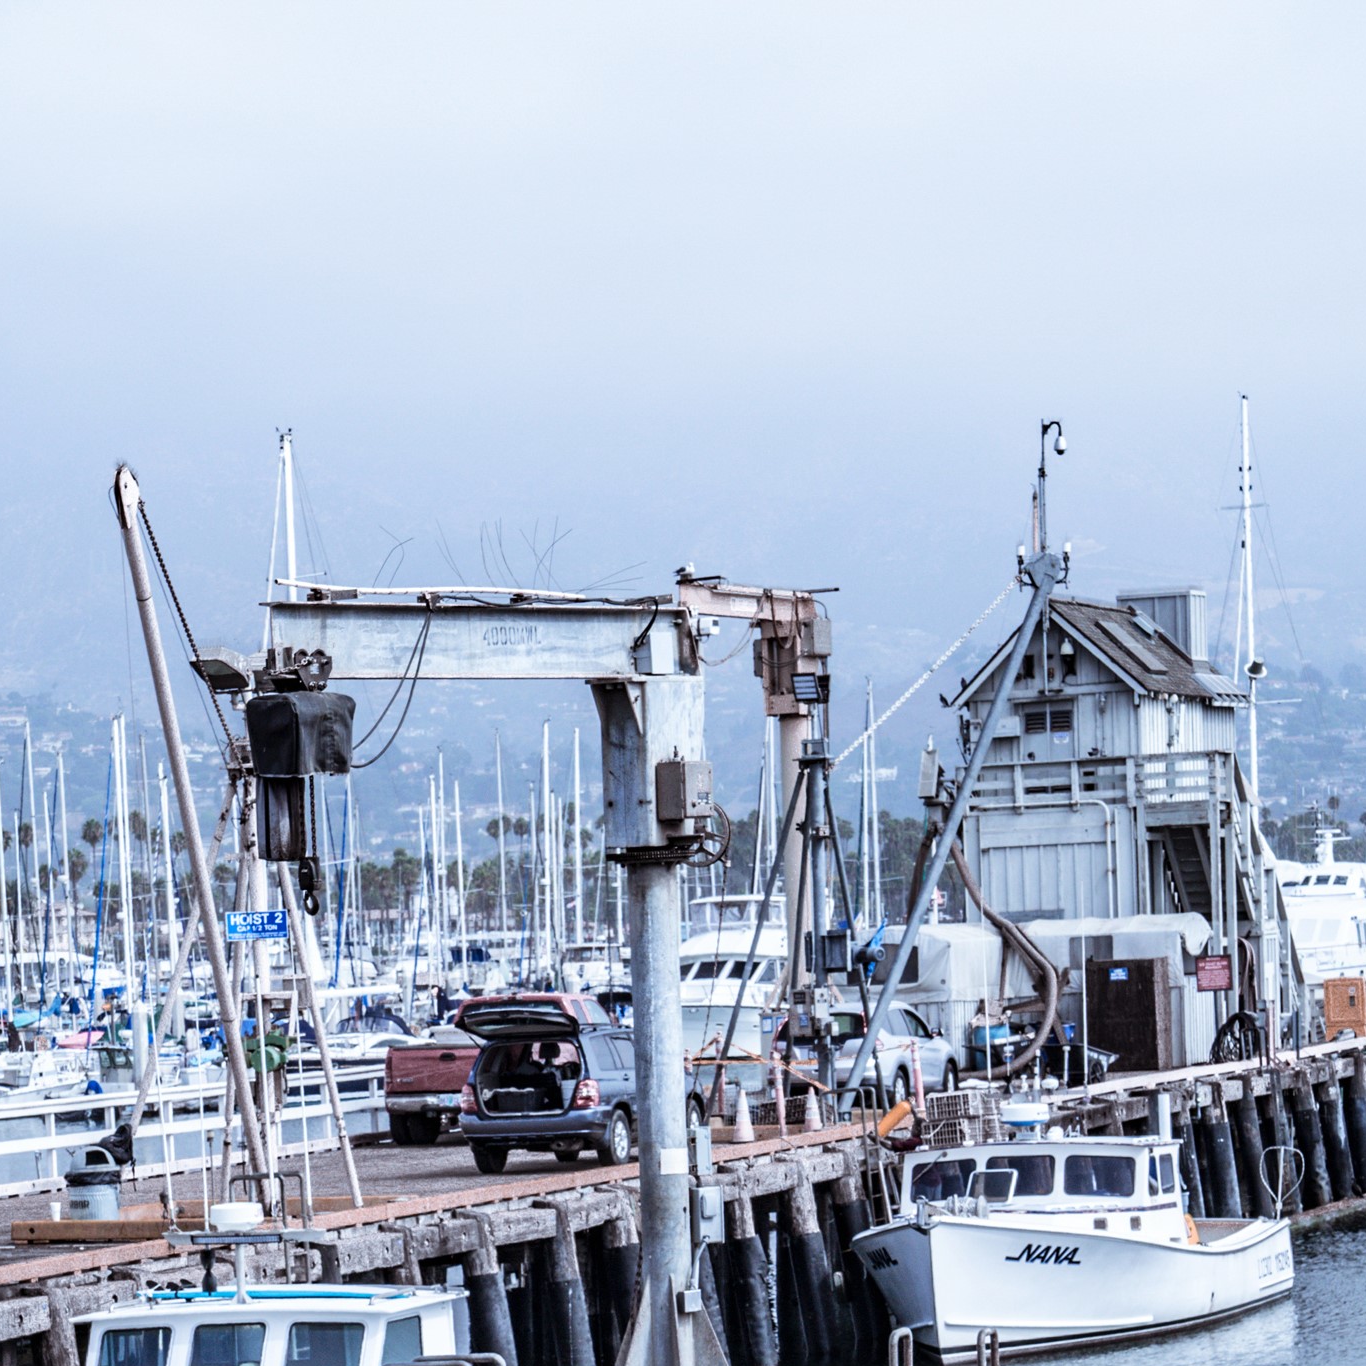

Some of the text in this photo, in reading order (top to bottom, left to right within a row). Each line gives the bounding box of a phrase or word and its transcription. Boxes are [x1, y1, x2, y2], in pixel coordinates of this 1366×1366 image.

[230, 912, 283, 926] HOIST 2
[1005, 1243, 1081, 1265] NANA
